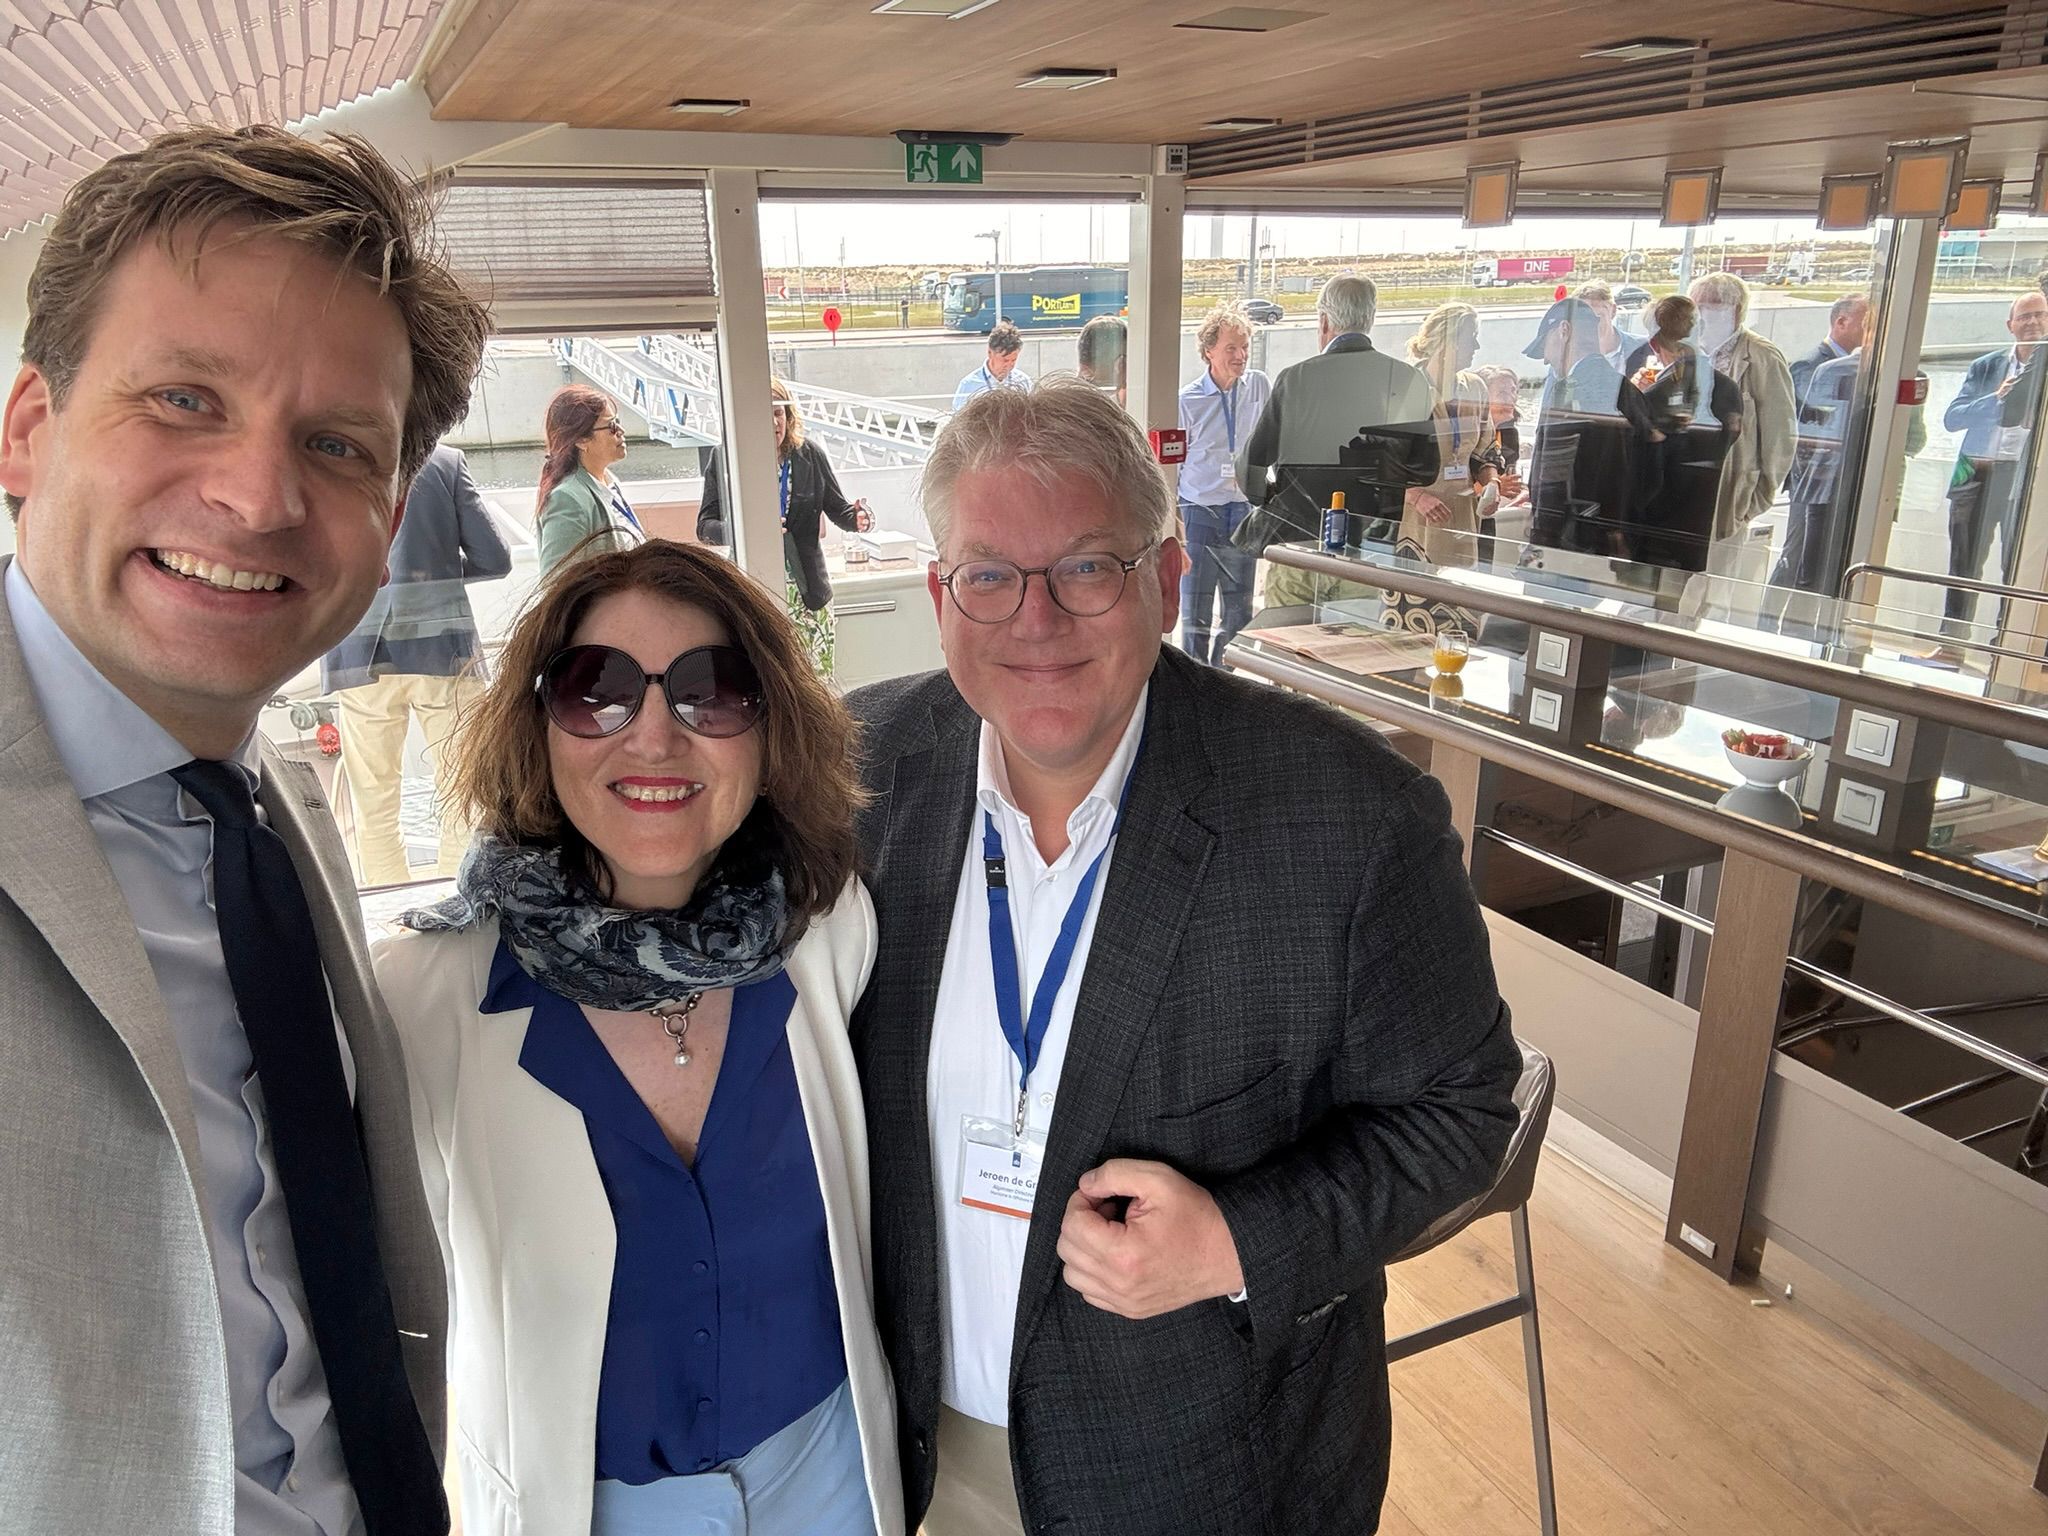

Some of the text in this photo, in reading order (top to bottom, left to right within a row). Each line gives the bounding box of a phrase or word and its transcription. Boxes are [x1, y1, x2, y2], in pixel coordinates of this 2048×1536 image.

[1523, 260, 1551, 273] ONE
[979, 1169, 1037, 1189] Jeroen de Gr
